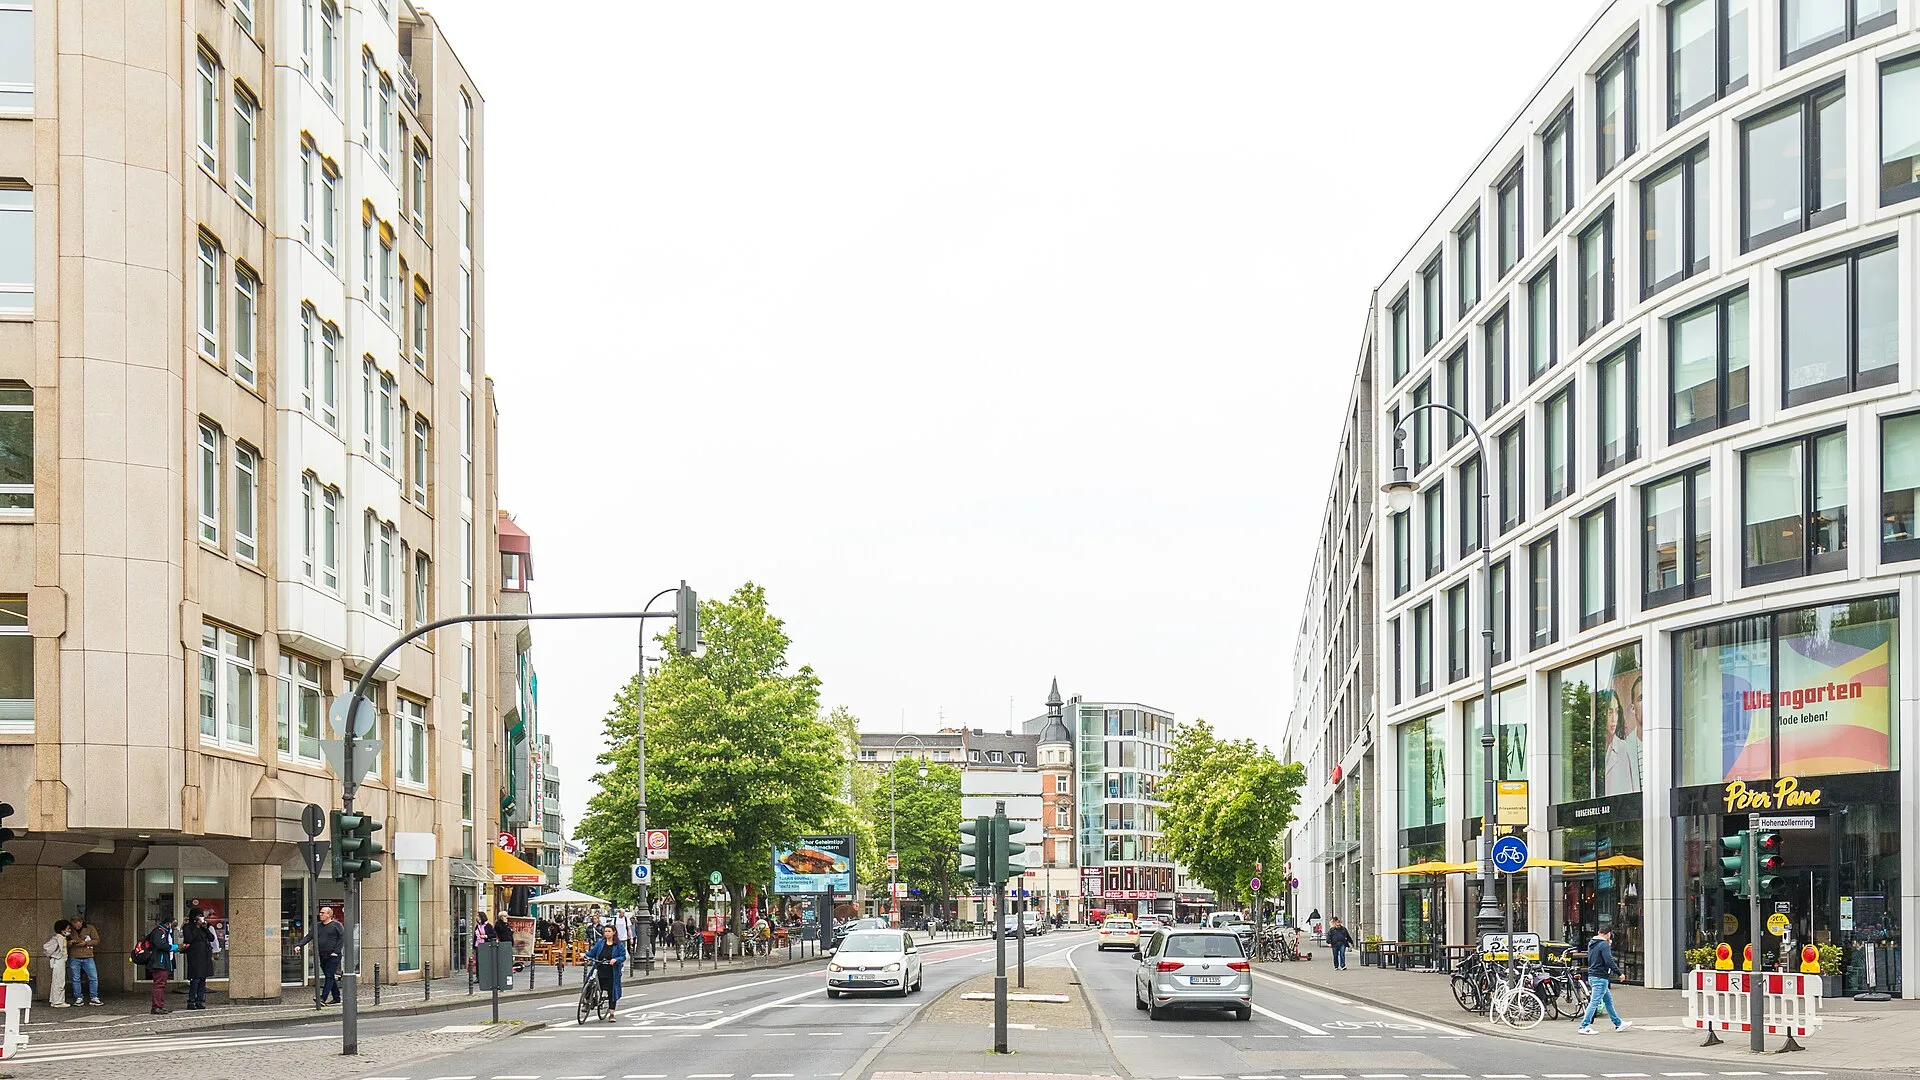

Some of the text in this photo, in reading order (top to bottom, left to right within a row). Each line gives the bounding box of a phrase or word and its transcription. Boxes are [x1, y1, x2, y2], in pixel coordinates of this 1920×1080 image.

[1743, 682, 1861, 710] Wengarten
[1800, 711, 1828, 723] leben!
[1723, 777, 1820, 813] Peter Pane
[1761, 818, 1814, 828] Hohenzollernring
[713, 874, 719, 883] H
